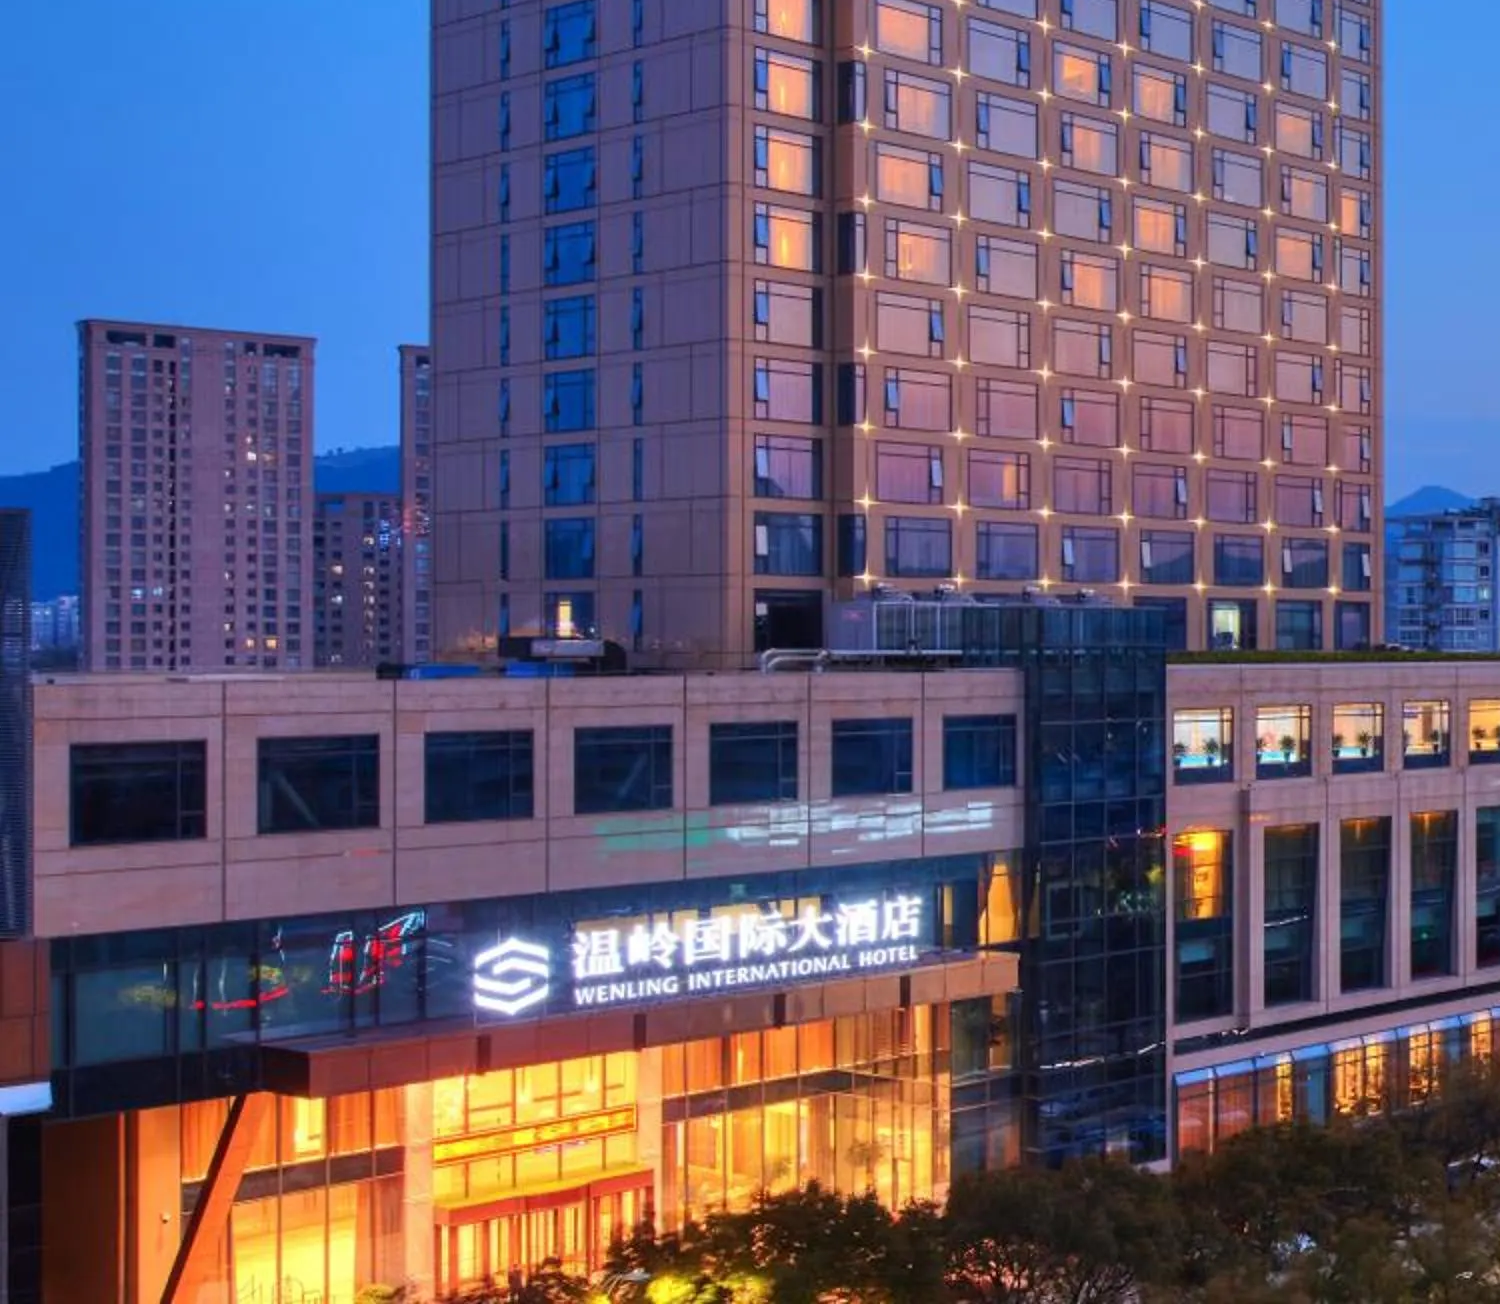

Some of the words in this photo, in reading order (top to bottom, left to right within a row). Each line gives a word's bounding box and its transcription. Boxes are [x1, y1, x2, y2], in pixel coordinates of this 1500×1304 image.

[572, 895, 922, 979] 温岭国际大酒店
[575, 975, 679, 1005] WENLING
[688, 953, 851, 991] INTERNATIONAL
[858, 944, 919, 967] HOTEL
